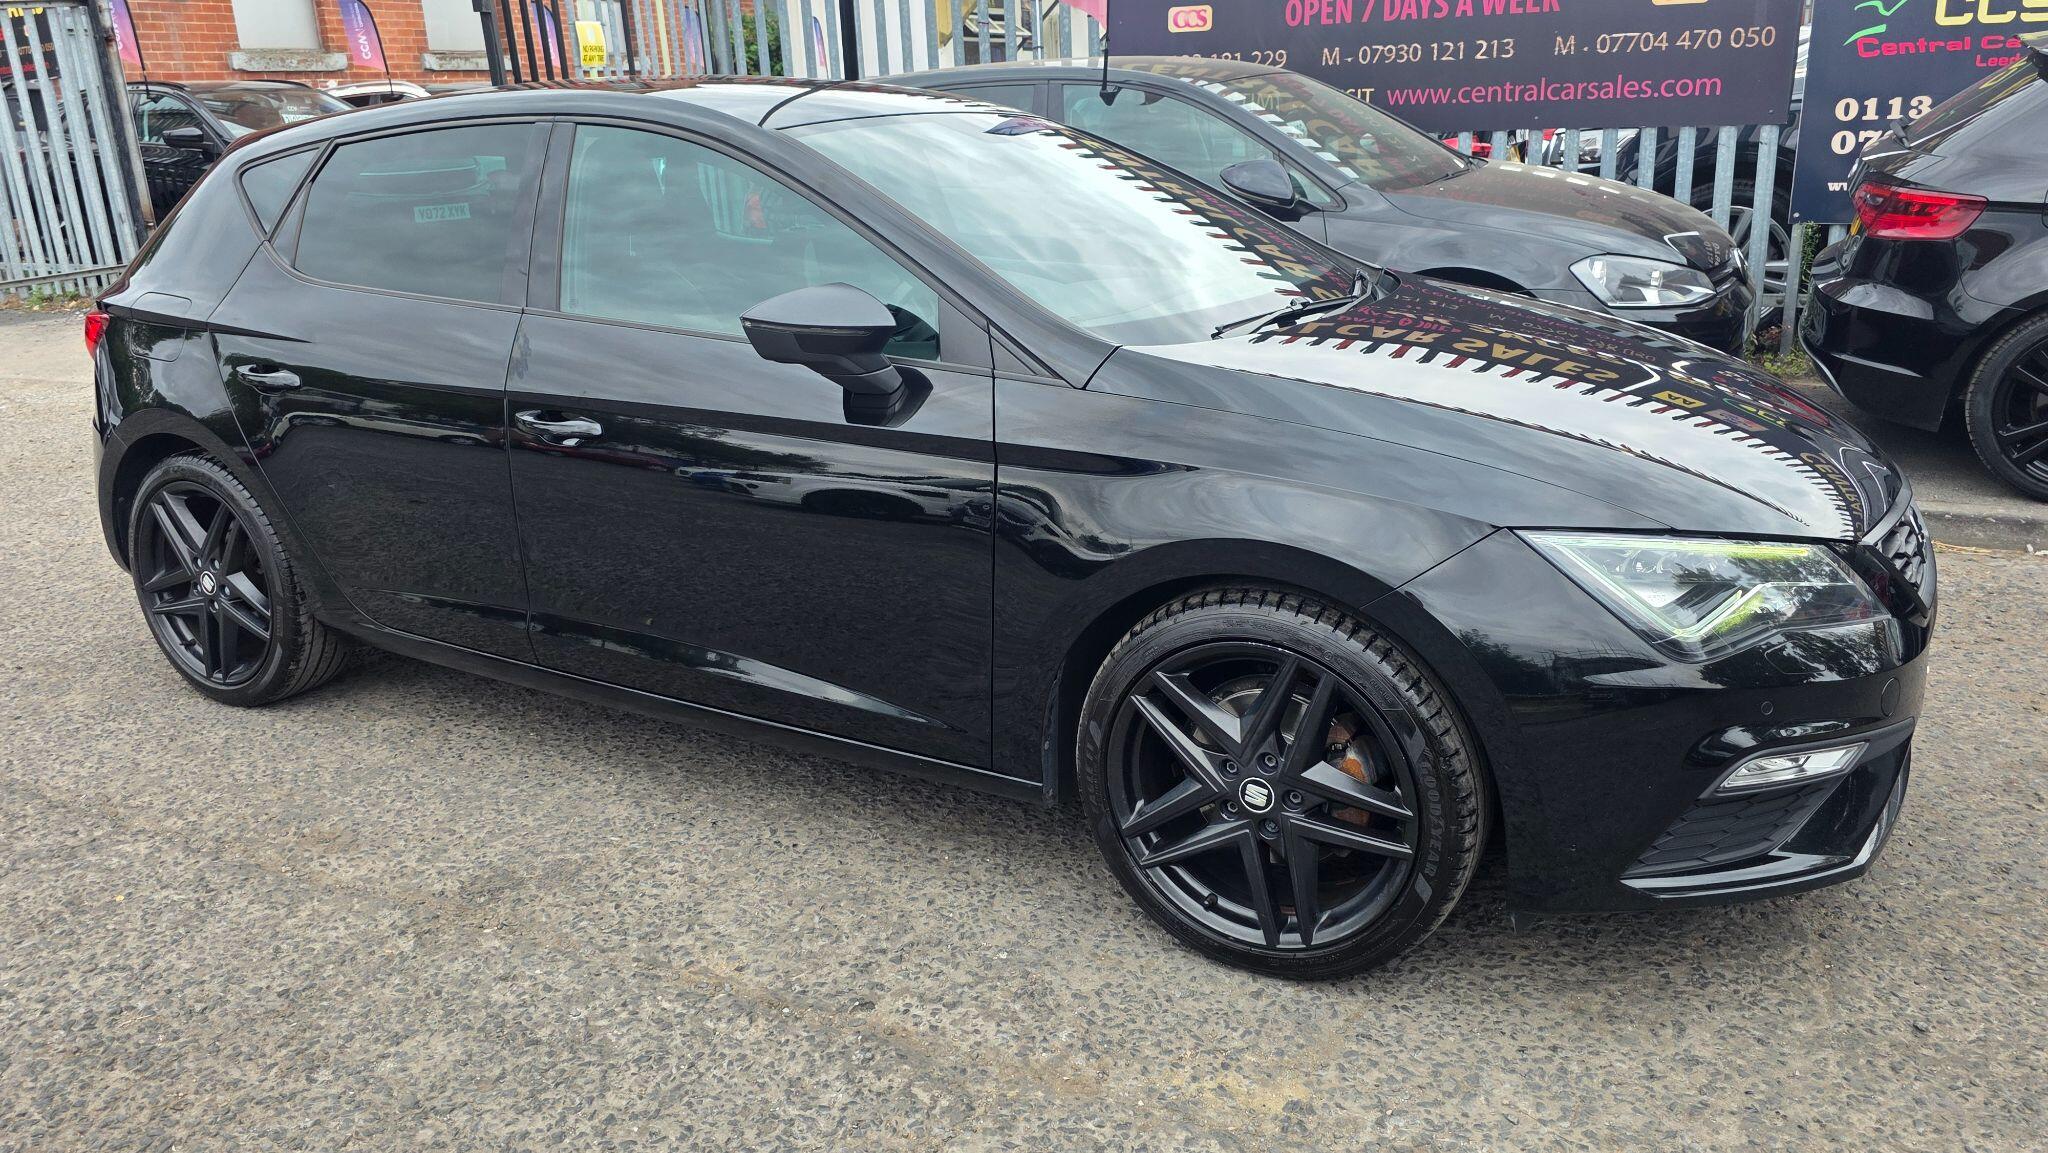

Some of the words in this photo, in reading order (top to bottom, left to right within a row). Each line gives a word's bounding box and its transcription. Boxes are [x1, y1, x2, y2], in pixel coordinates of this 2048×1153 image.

[1285, 0, 1352, 26] OPEN
[1383, 0, 1450, 21] DAYS
[1322, 46, 1340, 66] M
[1358, 43, 1422, 65] 07930
[1430, 41, 1465, 61] 121
[1474, 38, 1516, 60] 213
[1554, 34, 1576, 56] M
[1596, 31, 1668, 54] 07704
[1675, 28, 1722, 50] 470
[1730, 25, 1777, 49] 050
[1857, 36, 1971, 58] Central
[1387, 74, 1722, 106] www.centralcarsales.com
[1834, 95, 1933, 121] 0113
